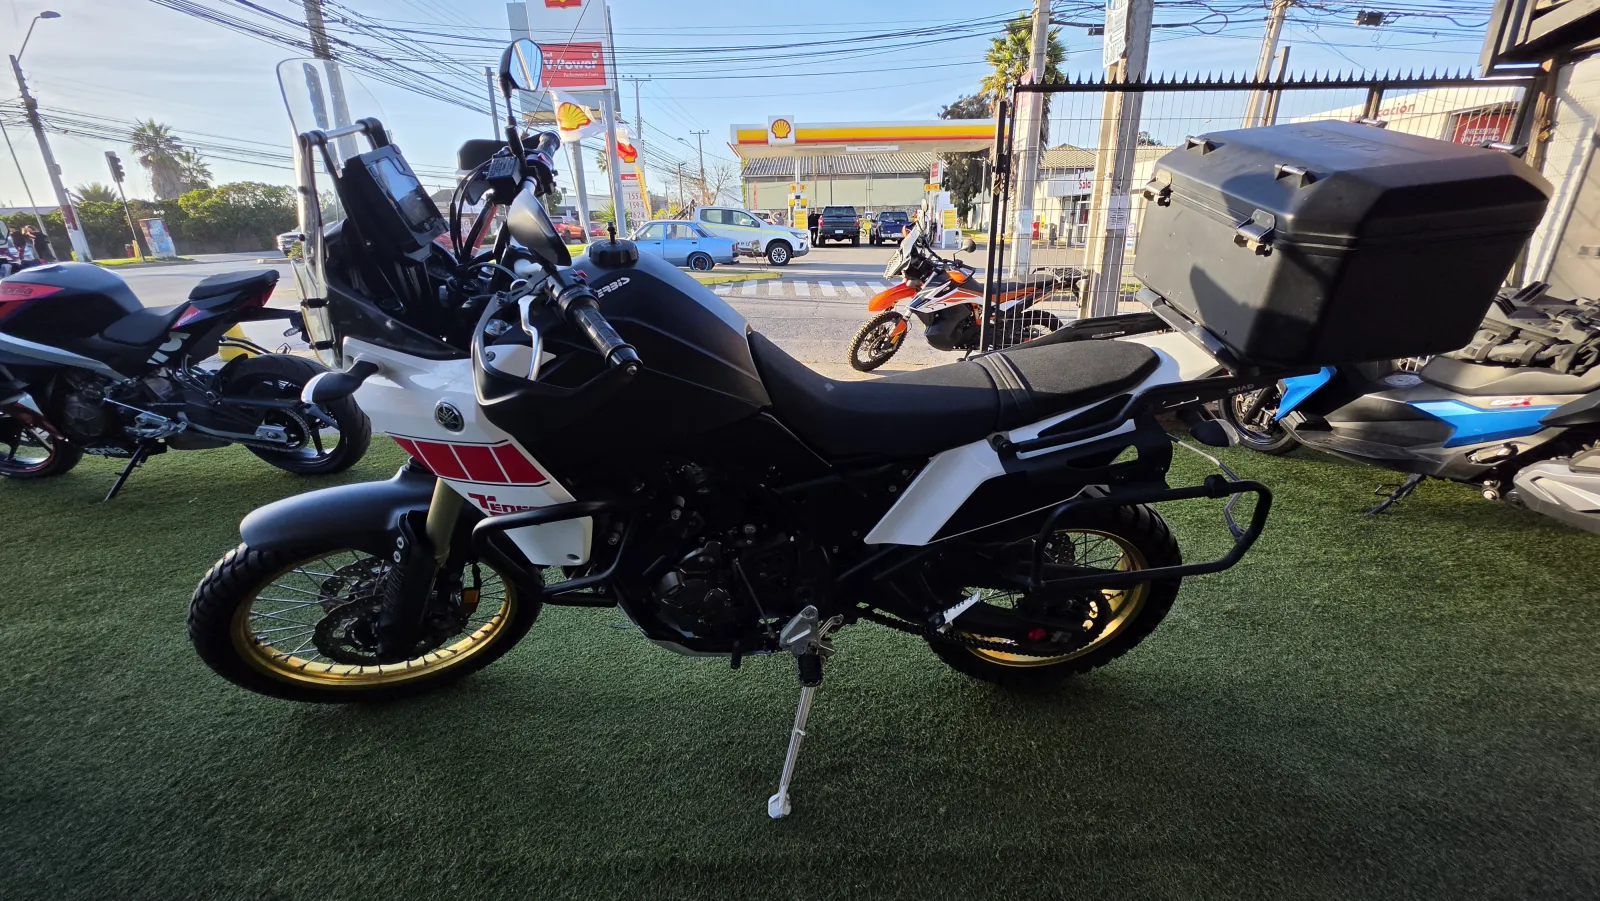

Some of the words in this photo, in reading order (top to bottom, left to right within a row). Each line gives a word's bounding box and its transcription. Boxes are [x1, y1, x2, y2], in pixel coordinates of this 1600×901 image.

[543, 59, 598, 70] V-Power
[596, 276, 631, 299] ERBIS
[1227, 384, 1255, 394] SHAD
